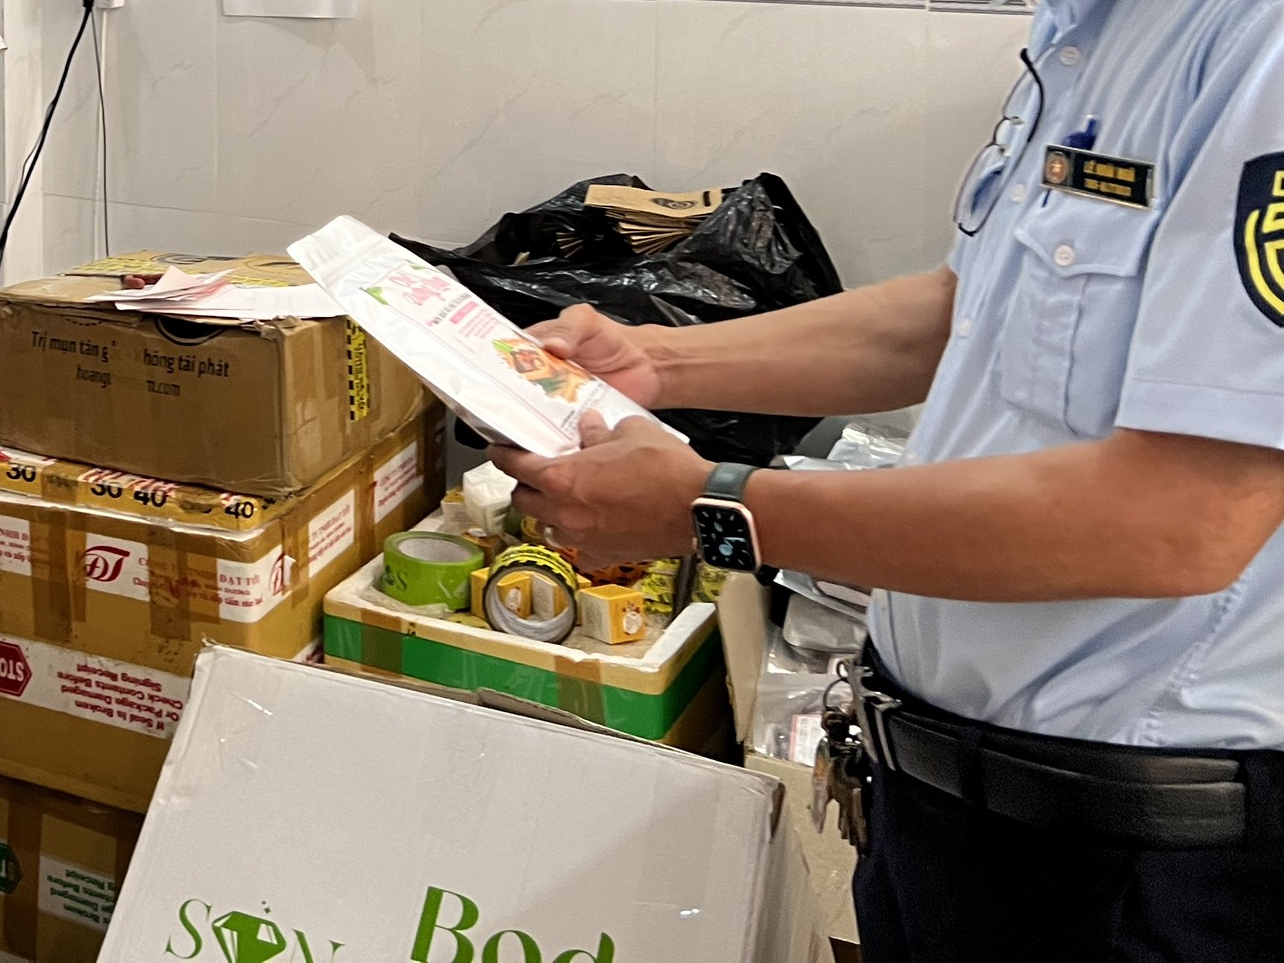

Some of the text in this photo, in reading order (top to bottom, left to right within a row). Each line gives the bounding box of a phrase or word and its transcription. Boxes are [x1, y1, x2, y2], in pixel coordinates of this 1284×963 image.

[32, 331, 47, 352] Trị
[49, 337, 77, 356] mụn
[143, 348, 174, 374] hông
[198, 358, 230, 379] phát
[224, 500, 255, 520] 40
[57, 671, 183, 710] Check Contents Before
[61, 685, 112, 705] Damaged
[75, 700, 113, 718] Broken
[115, 697, 162, 718] Package
